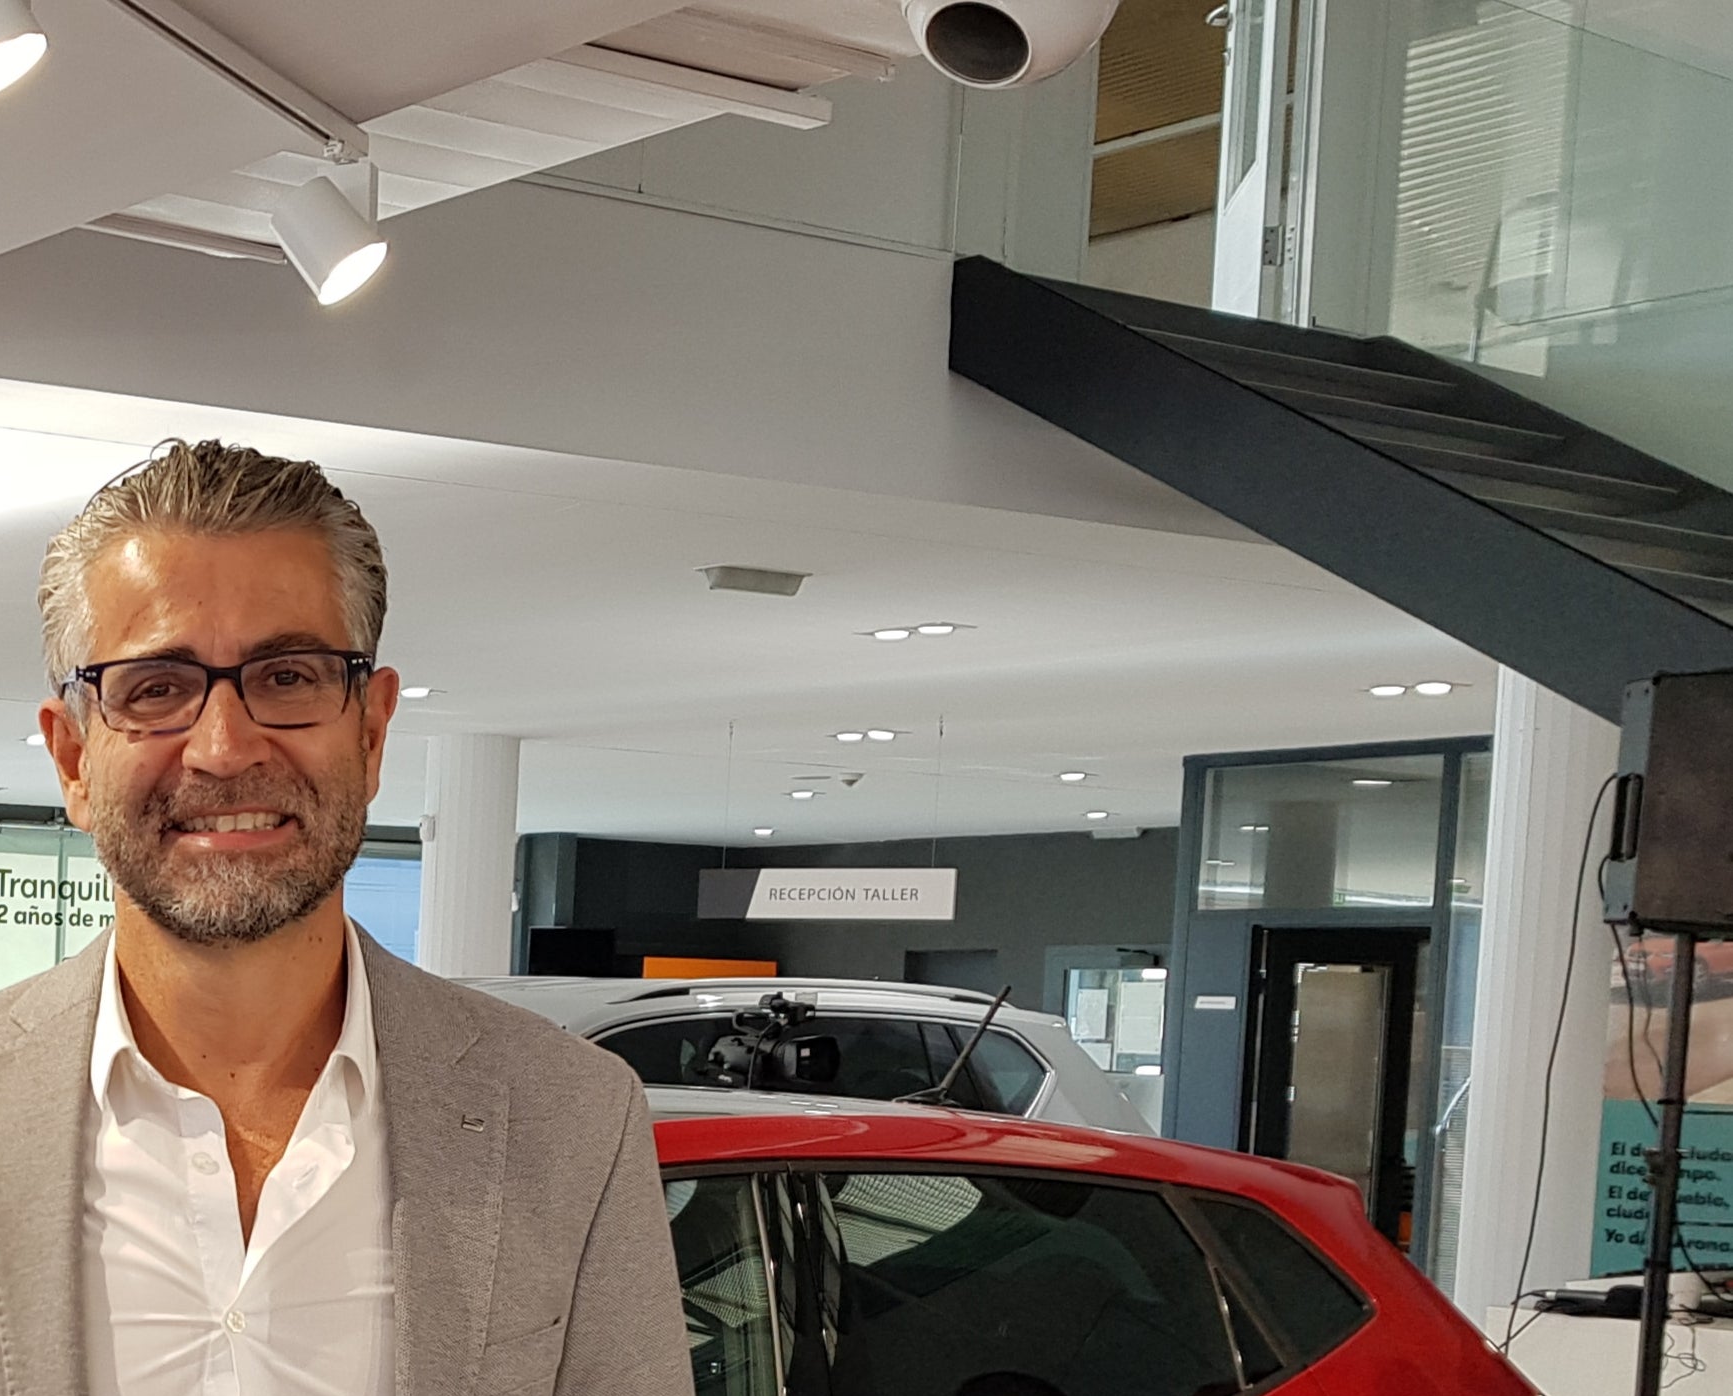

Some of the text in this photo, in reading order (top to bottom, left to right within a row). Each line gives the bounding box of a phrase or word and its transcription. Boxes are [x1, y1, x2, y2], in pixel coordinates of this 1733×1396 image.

[769, 886, 919, 901] RECEPCIÓN TALLER
[14, 905, 64, 926] años
[69, 907, 94, 927] de
[1611, 1141, 1625, 1156] El
[1608, 1185, 1623, 1199] El
[1605, 1228, 1625, 1243] Yo
